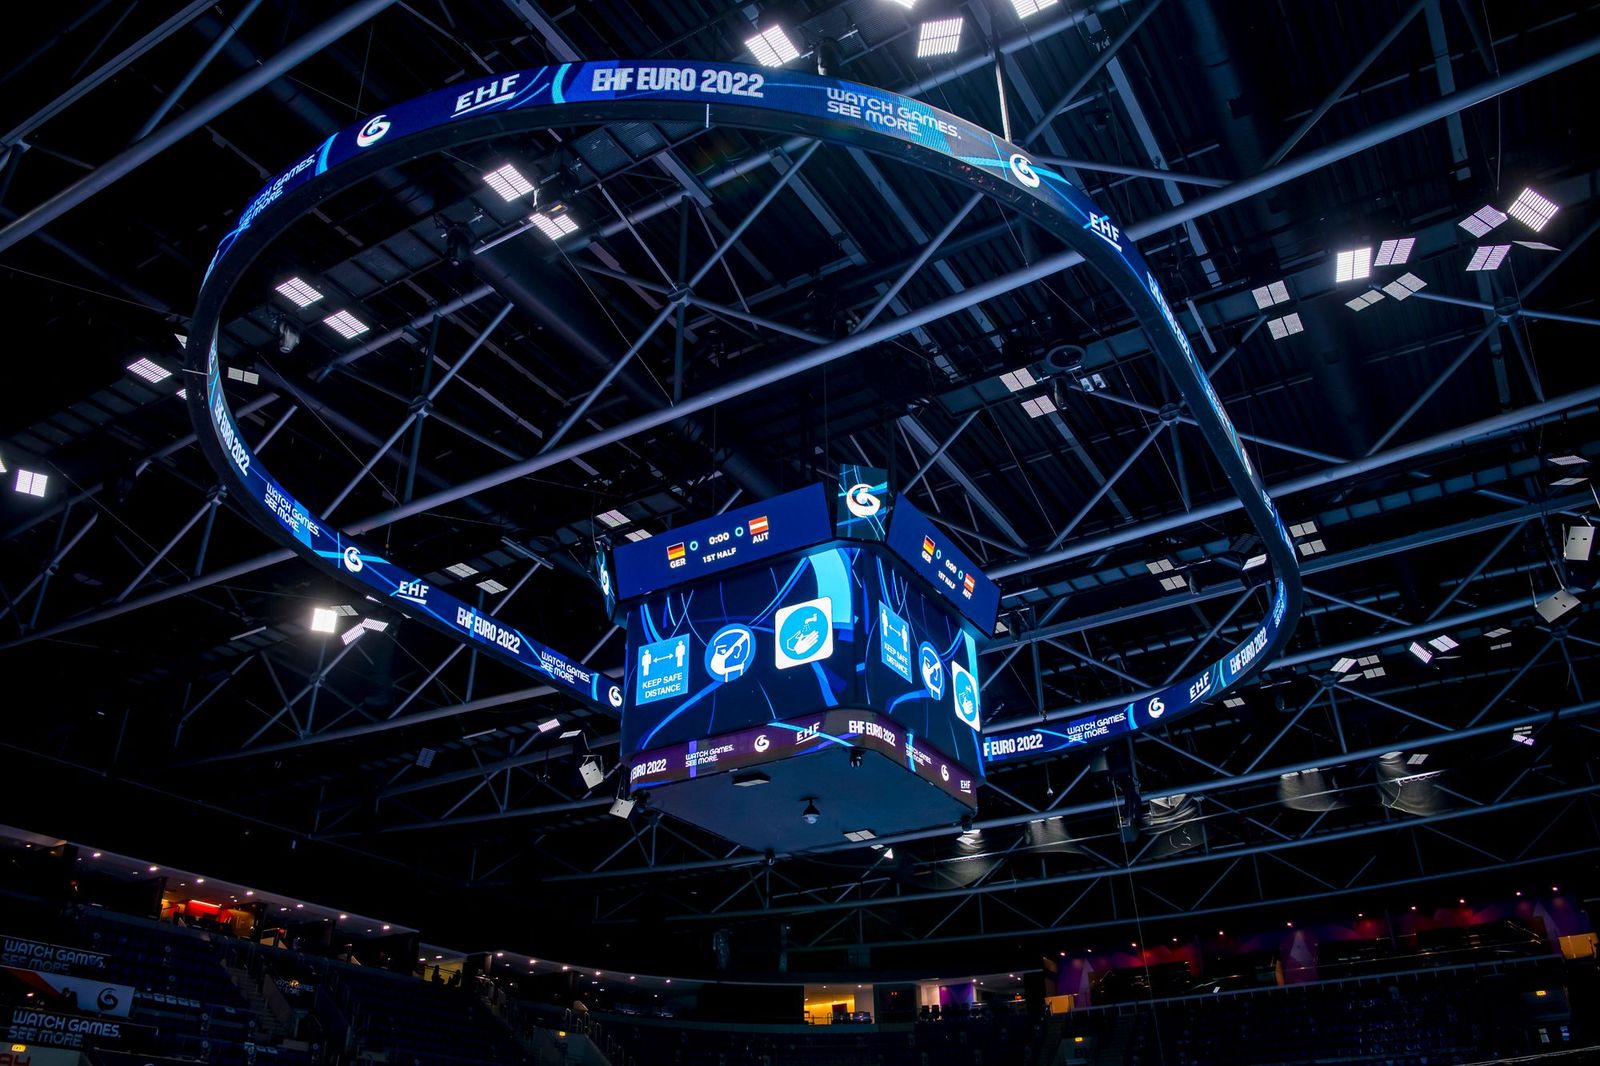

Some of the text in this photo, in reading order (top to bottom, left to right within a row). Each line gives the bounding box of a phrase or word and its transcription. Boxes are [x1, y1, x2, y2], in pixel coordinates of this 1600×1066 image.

[454, 73, 520, 112] EHF
[591, 67, 764, 98] EHF EURO 2022
[826, 87, 962, 140] WATCH GAMES.
[827, 101, 861, 118] SEE
[1089, 211, 1119, 242] EHF
[231, 437, 250, 476] 2022
[264, 493, 278, 512] SEE
[266, 482, 320, 537] WATCH GAMES.
[709, 532, 730, 545] 0:00
[752, 532, 769, 544] AUT
[670, 558, 686, 569] GER
[702, 547, 737, 564] 1ST HALF
[399, 580, 429, 598] EHF
[456, 606, 520, 654] EHF EURO 2022
[1240, 642, 1255, 667] EURO
[1254, 626, 1268, 651] 2022
[540, 660, 554, 673] SEE
[541, 651, 591, 683] WATCH GAMES.
[642, 672, 683, 689] KEEP SAFE
[645, 683, 681, 699] DISTANCE
[1189, 671, 1209, 700] EHF
[796, 721, 820, 742] EHF
[849, 720, 865, 734] EHF
[866, 722, 883, 739] EURO
[1067, 712, 1126, 735] WATCH GAMES.
[991, 738, 1016, 756] EURO
[1016, 733, 1044, 752] 2022
[1068, 733, 1083, 743] SEE
[685, 744, 735, 761] WATCH GAMES.
[647, 758, 667, 774] 2022
[960, 780, 971, 789] EHF
[4, 939, 107, 969] WATCH GAMES.
[12, 1007, 122, 1038] WATCH GAMES.
[8, 1025, 36, 1040] SEE
[39, 1030, 84, 1048] MORE.
